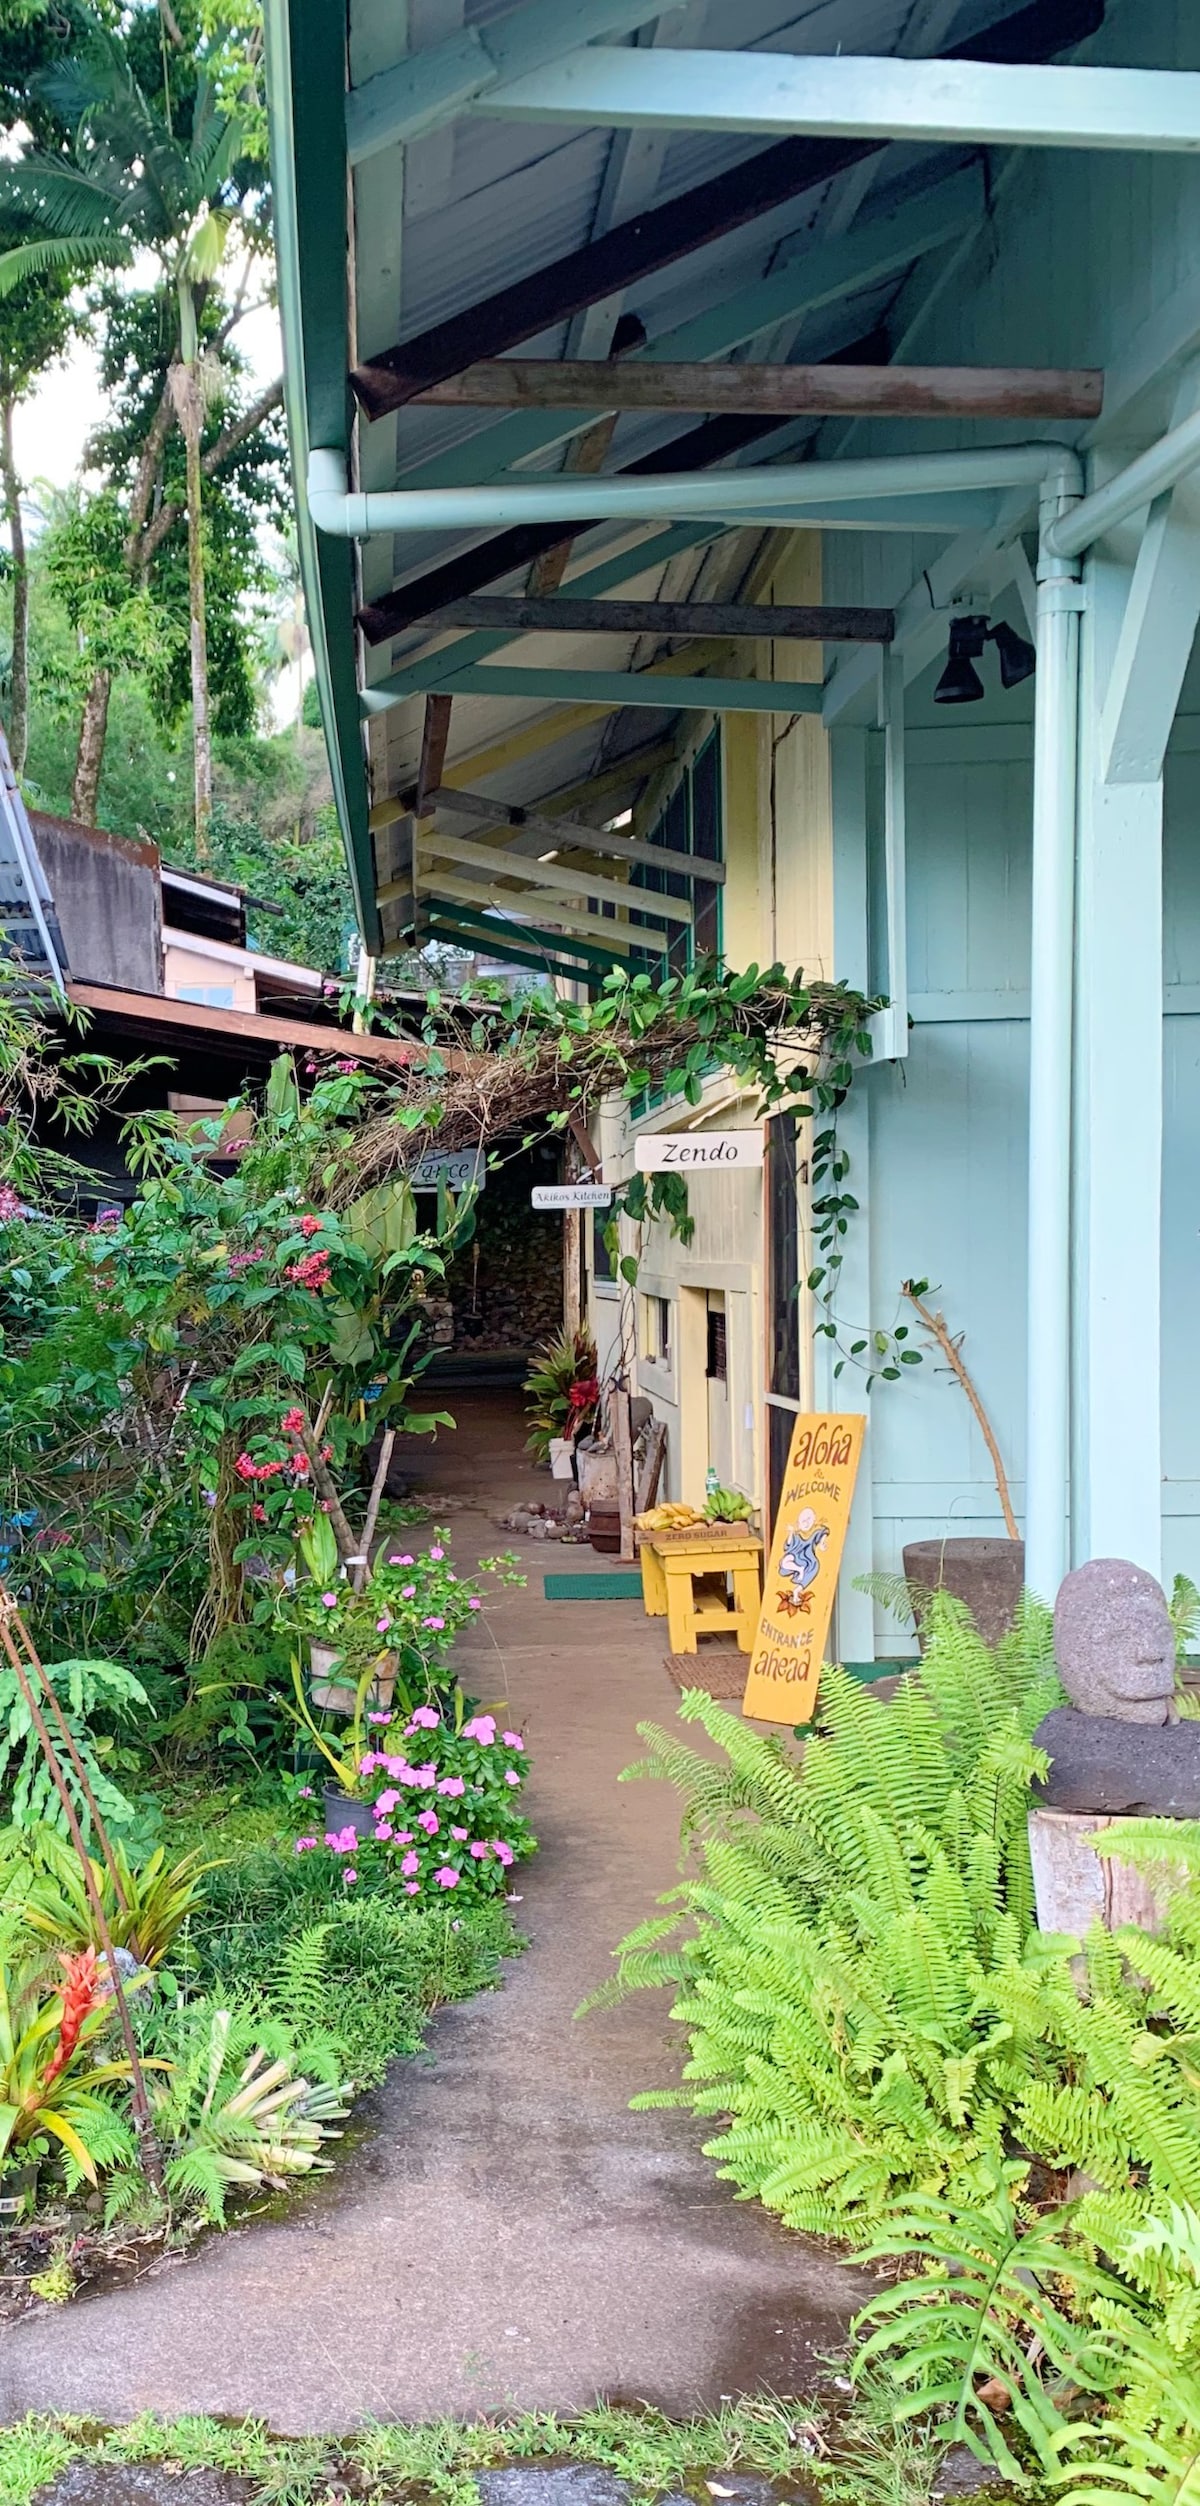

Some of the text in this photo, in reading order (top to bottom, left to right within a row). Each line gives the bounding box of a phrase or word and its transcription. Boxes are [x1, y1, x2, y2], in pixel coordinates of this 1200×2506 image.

[661, 1140, 739, 1163] Zendo
[571, 1190, 610, 1201] Kitchen
[793, 1421, 853, 1470] aloha
[784, 1480, 841, 1507] WELCOME
[665, 1529, 728, 1541] ZERO SUGAR
[760, 1616, 815, 1649] ENTRANCE
[754, 1647, 812, 1684] ahead
